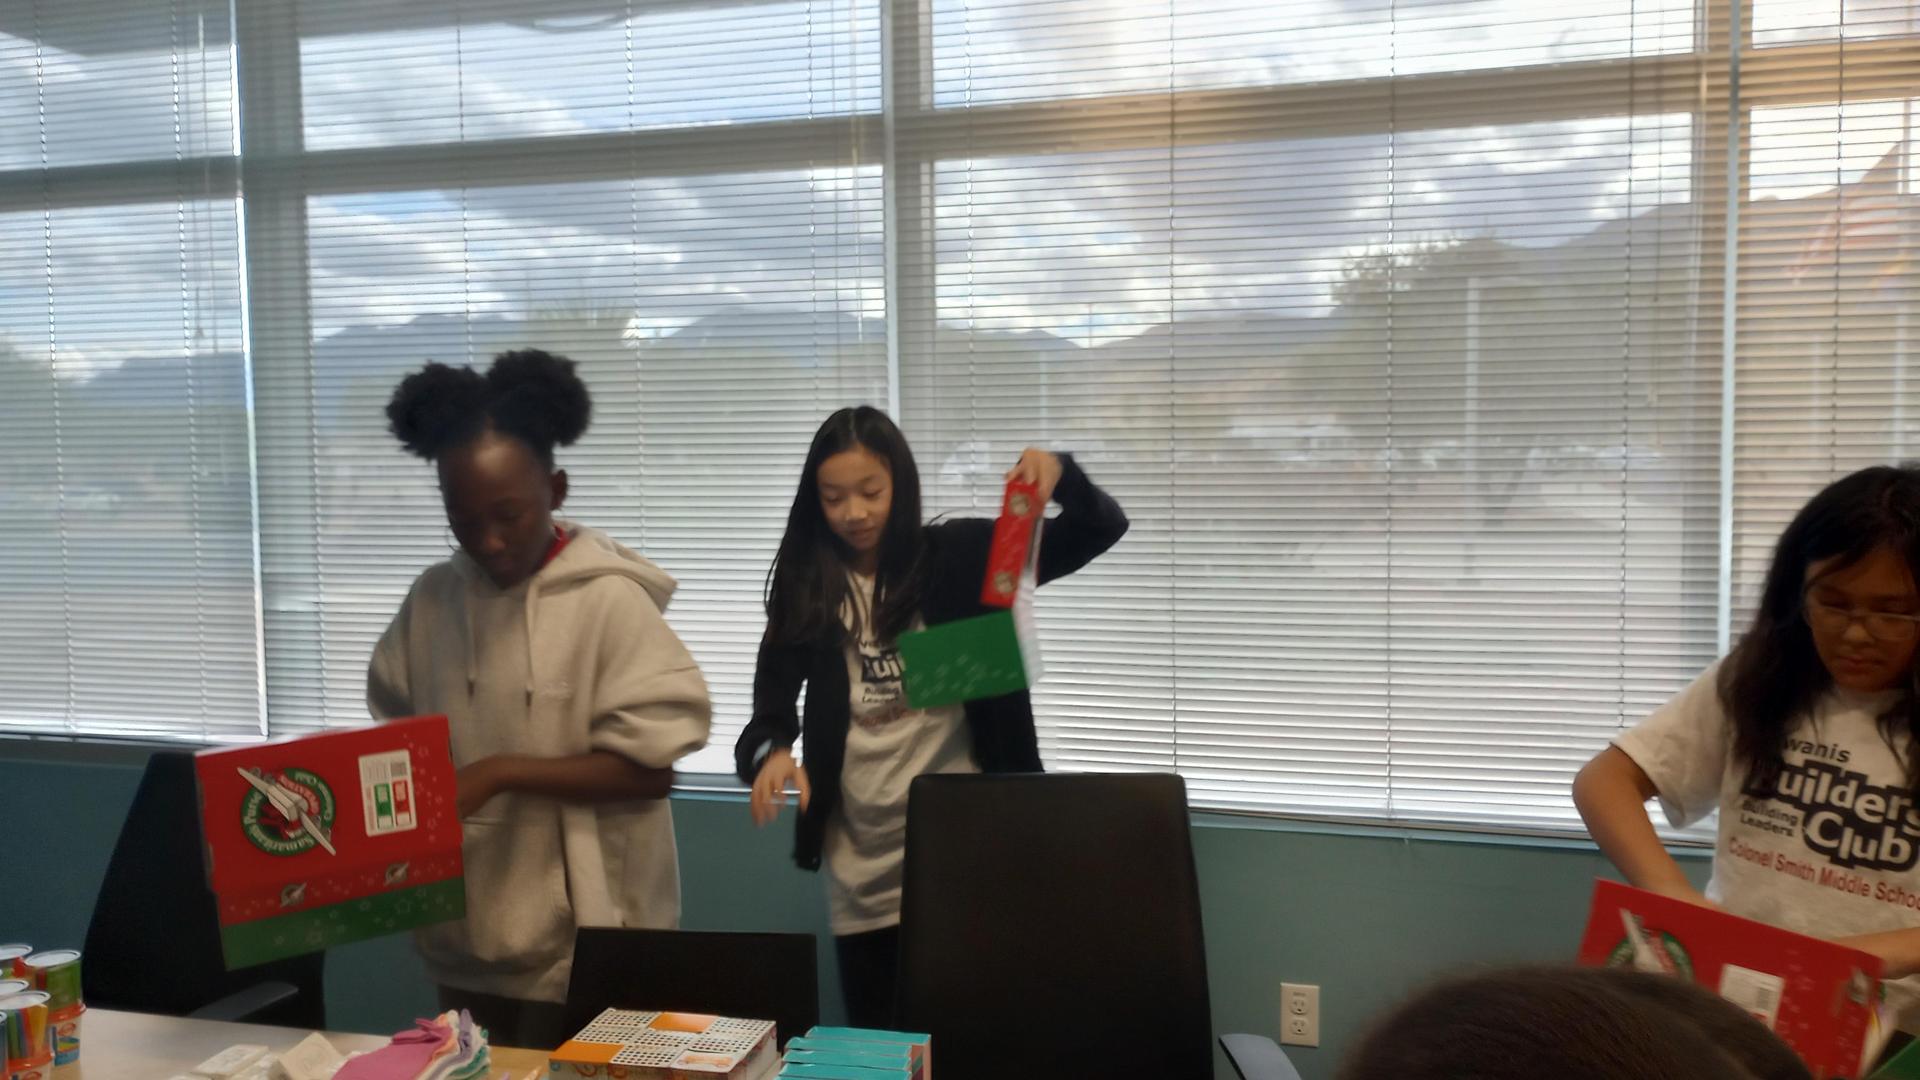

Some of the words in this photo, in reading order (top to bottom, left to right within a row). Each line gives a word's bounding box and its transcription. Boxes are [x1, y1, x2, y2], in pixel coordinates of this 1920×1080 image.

[1752, 765, 1920, 838] uilders
[1729, 835, 1774, 869] Colonel
[1775, 853, 1816, 882] Smith
[1819, 866, 1871, 897] Middle
[1805, 810, 1913, 866] Club
